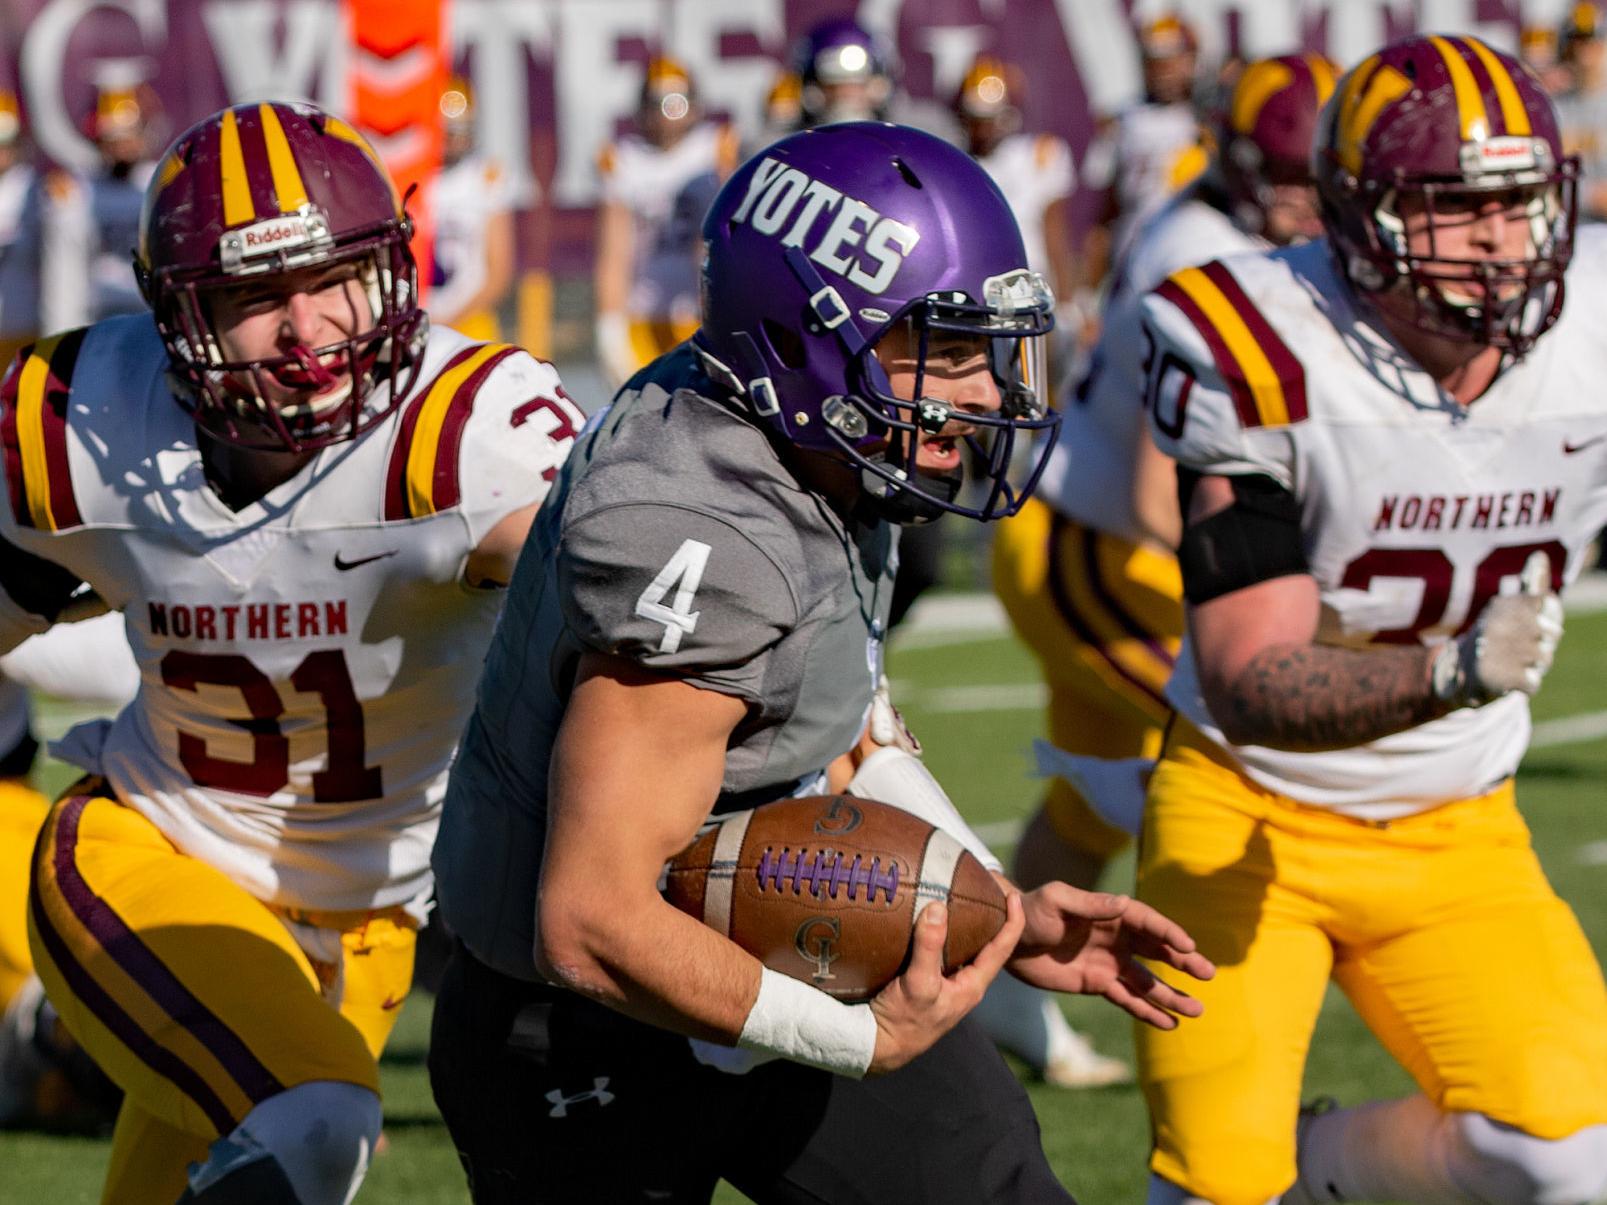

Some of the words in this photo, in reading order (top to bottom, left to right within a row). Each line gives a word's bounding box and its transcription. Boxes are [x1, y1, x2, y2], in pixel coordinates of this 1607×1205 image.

[731, 157, 920, 294] YOTES
[1374, 487, 1561, 530] NORTHERN
[148, 599, 348, 640] NORTHERN
[635, 538, 712, 654] 4
[160, 649, 384, 804] 31
